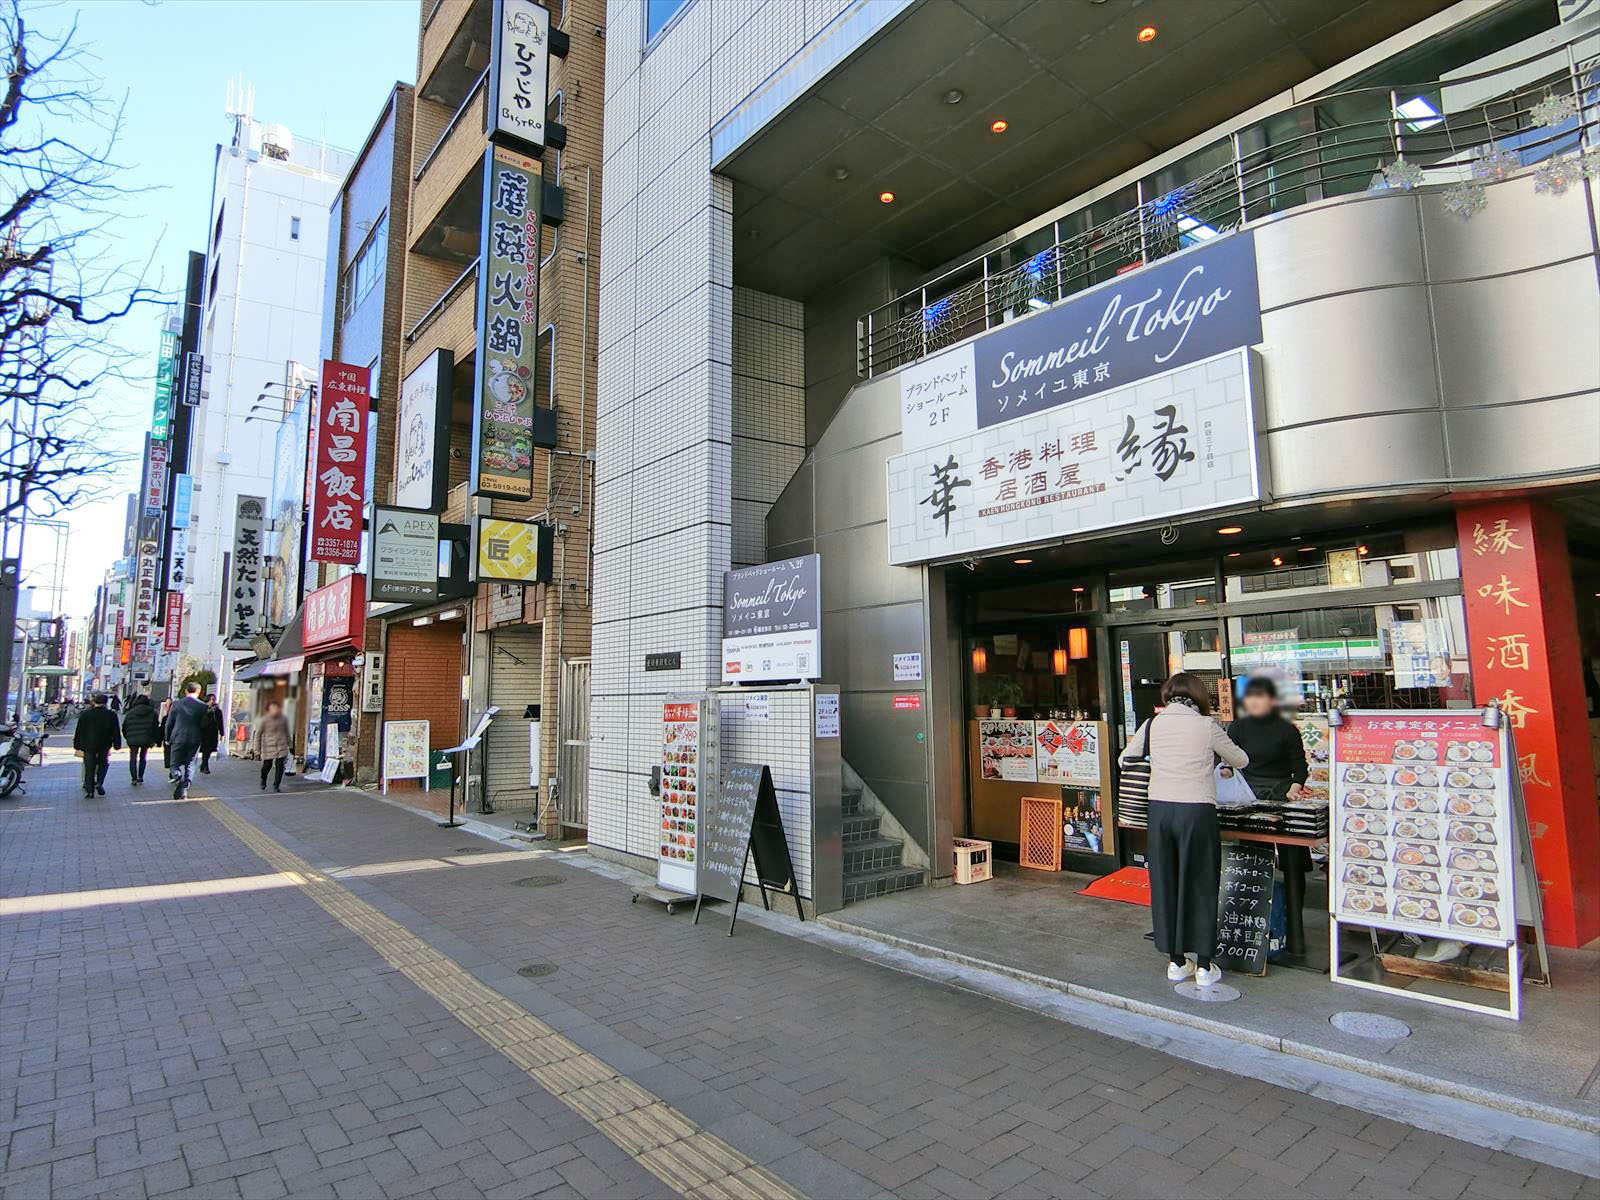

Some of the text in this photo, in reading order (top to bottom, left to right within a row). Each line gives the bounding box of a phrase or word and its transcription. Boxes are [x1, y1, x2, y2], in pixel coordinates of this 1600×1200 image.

[514, 42, 536, 110] ひつじや
[992, 264, 1232, 389] Sommeil Tokyo
[327, 380, 367, 395] 広東料理
[338, 370, 357, 382] 中国
[906, 365, 968, 400] ブランドベッド
[998, 362, 1111, 413] ソメイユ東京
[906, 384, 968, 415] ショールーム
[979, 431, 1098, 481] 香港料理
[1115, 404, 1195, 482] 縁
[320, 396, 361, 531] 南昌飯店
[919, 454, 972, 539] 華
[995, 463, 1082, 501] 居酒屋
[982, 485, 1101, 516] KAEN HONGKONG RESTAURANT
[403, 520, 435, 531] APEX
[323, 547, 358, 558] 3356-2827
[324, 538, 358, 549] 3357-1874
[487, 538, 510, 561] 匠
[307, 583, 349, 632] 南昌飯店
[730, 574, 808, 617] Sommeil Tokyo
[1367, 720, 1481, 731] お食事定食メニュ
[1215, 942, 1259, 963] 500円
